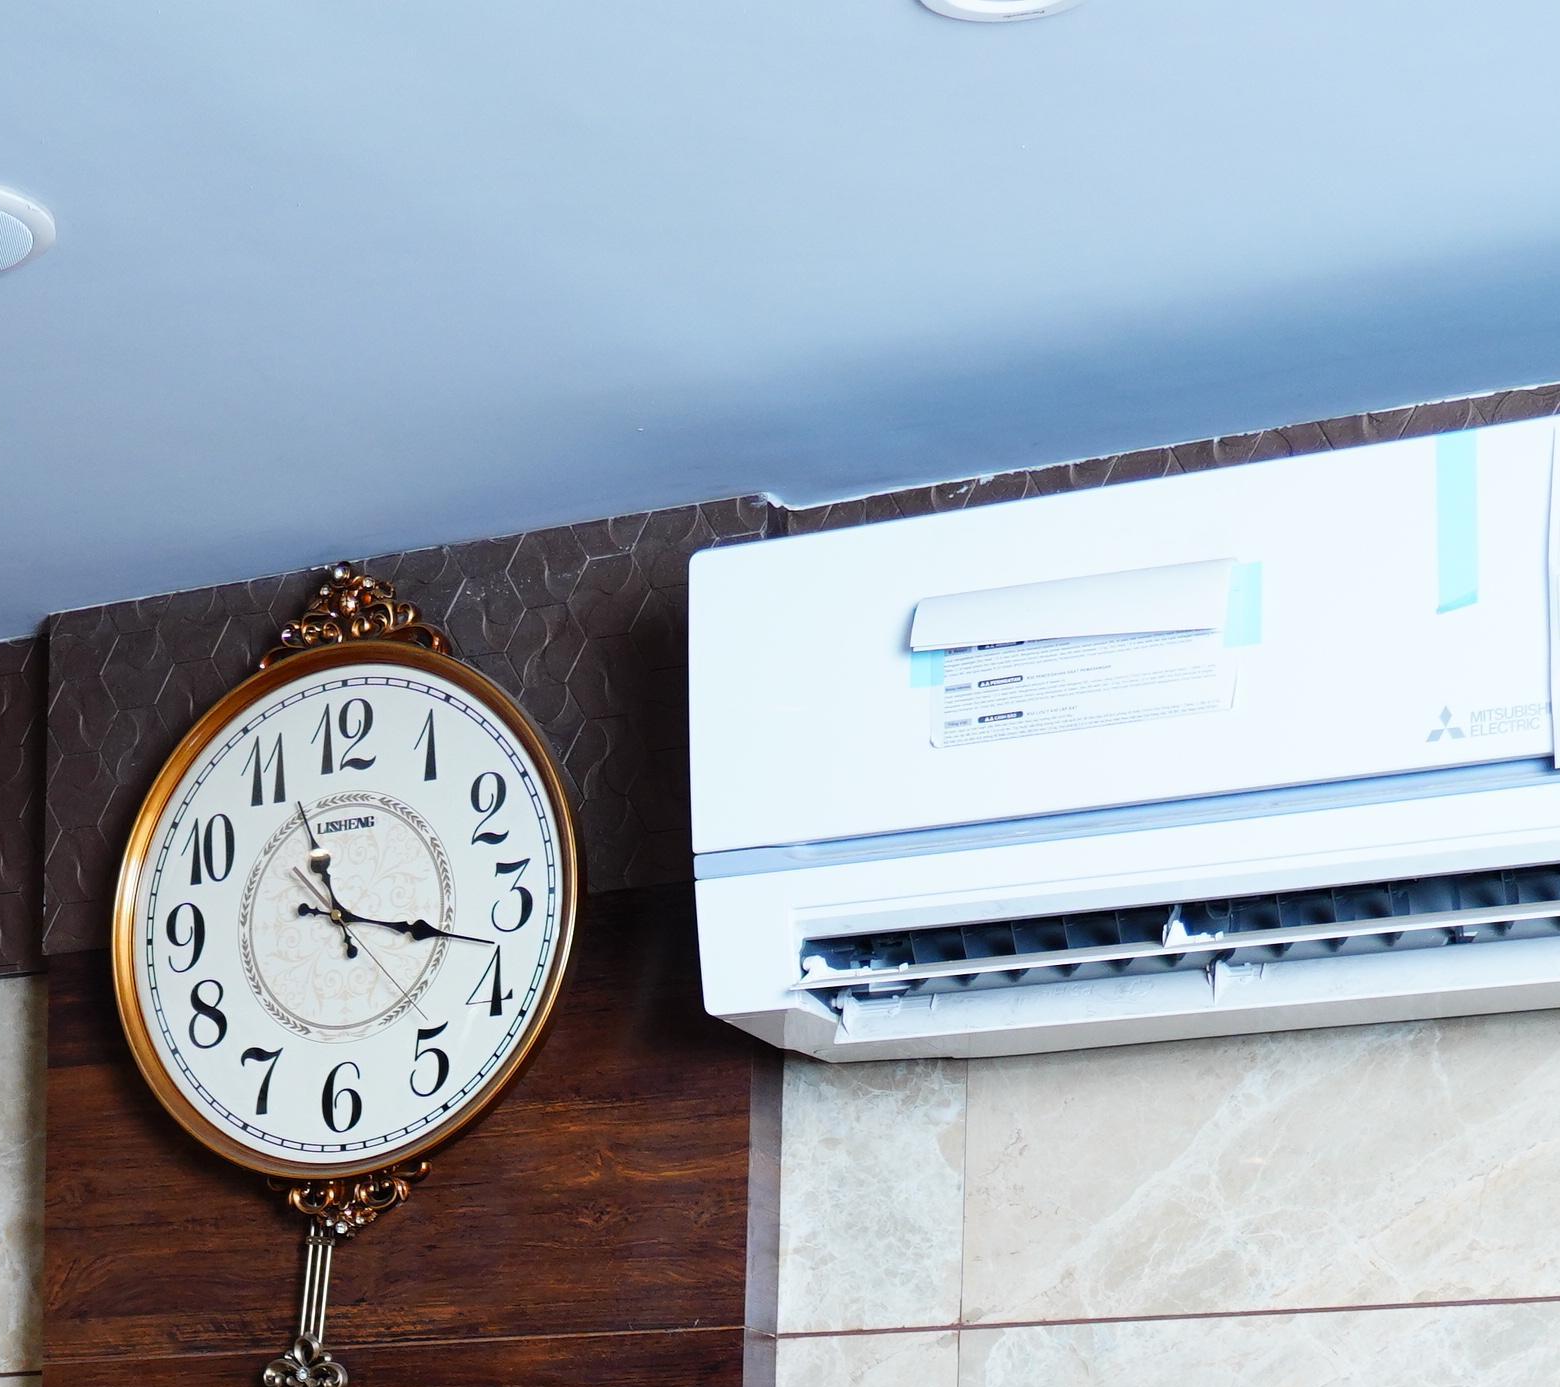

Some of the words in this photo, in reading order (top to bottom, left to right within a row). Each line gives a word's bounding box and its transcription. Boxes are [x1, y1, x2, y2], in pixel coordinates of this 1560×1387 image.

[310, 698, 378, 776] 12
[413, 708, 437, 782] 1
[1470, 702, 1551, 723] MITSUBISH
[1470, 717, 1541, 737] ELECTRIC
[240, 732, 287, 808] 11
[317, 815, 376, 835] LISHENG
[469, 771, 510, 846] 2
[180, 813, 235, 886] 10
[491, 858, 533, 933] 3
[166, 902, 206, 973] 9
[188, 979, 228, 1049] 8
[465, 944, 514, 1018] 4
[240, 1047, 284, 1117] 7
[409, 1021, 450, 1098] 5
[321, 1061, 363, 1134] 6
